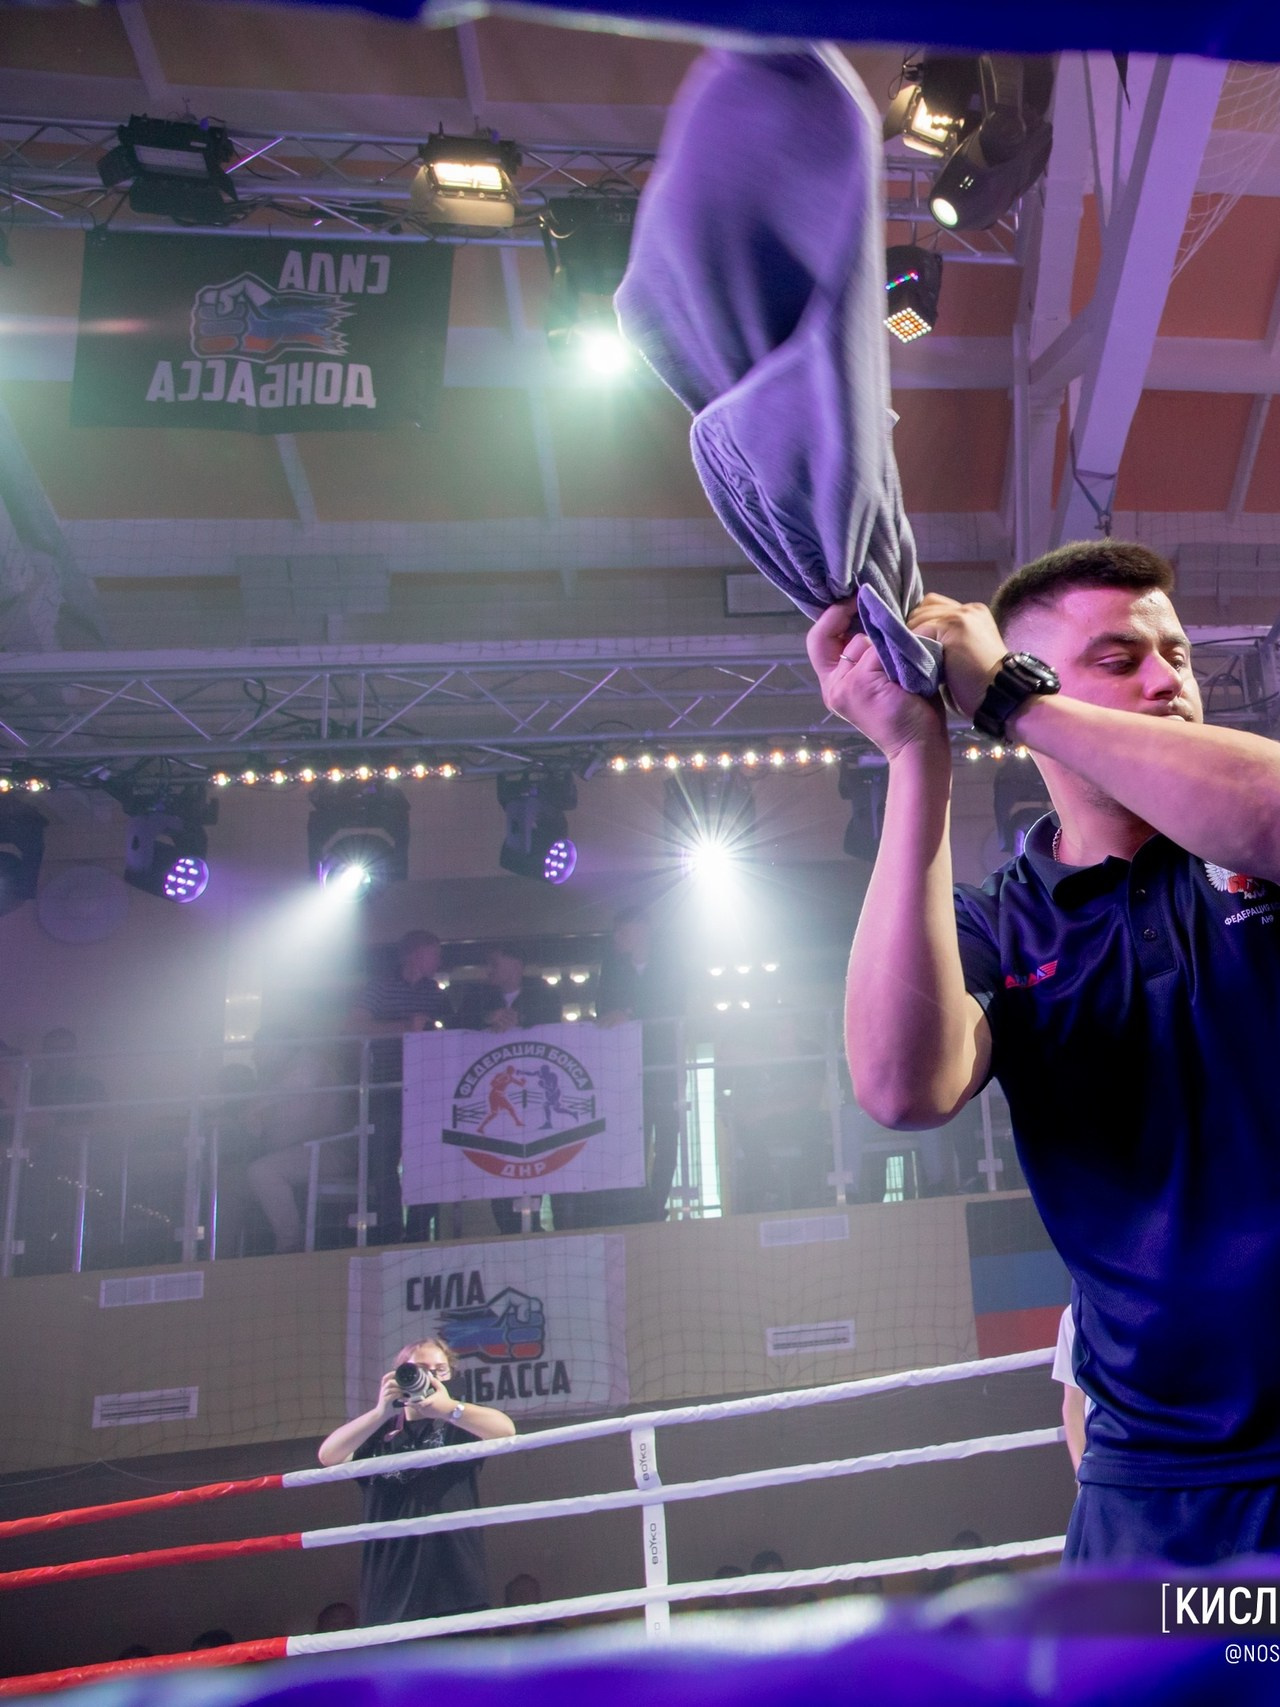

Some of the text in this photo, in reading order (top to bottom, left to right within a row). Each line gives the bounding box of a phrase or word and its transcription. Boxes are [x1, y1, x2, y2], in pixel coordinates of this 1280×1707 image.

[459, 1044, 590, 1096] ФЕДЕРАЦИЯ БОКСА
[500, 1162, 547, 1177] ДНР
[406, 1270, 486, 1312] СИЛА
[639, 1442, 650, 1482] BOYKO
[649, 1522, 659, 1565] BOYKO
